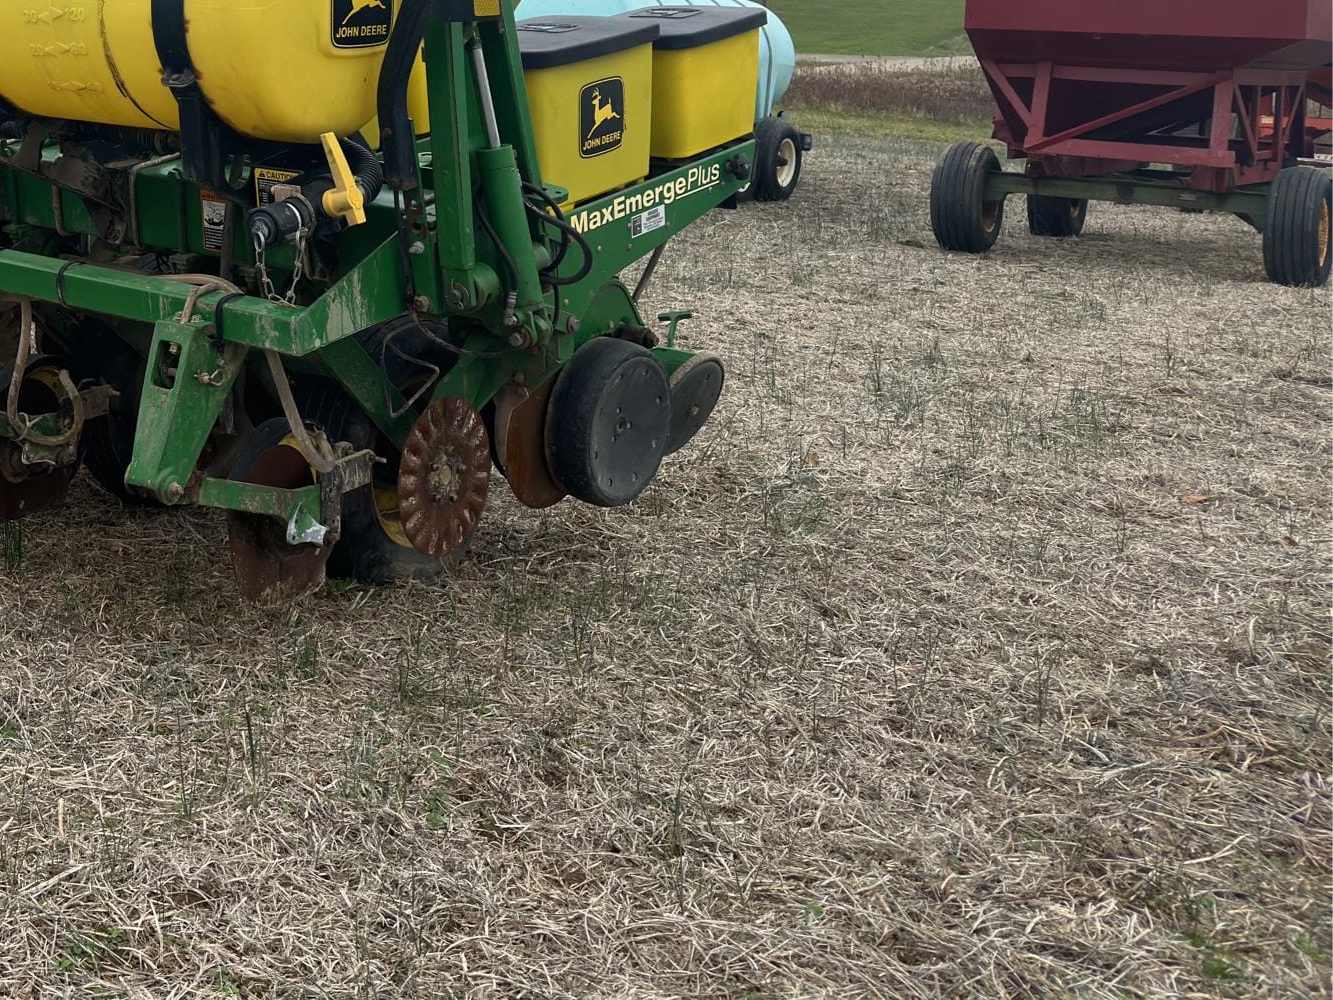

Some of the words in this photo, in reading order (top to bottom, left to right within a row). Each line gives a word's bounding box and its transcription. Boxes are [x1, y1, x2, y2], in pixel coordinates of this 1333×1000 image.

[23, 10, 38, 24] 30
[66, 7, 86, 21] 120
[336, 26, 359, 38] JOHN
[360, 24, 387, 37] DEERE
[583, 137, 601, 150] JOHN
[601, 130, 622, 145] DEERE
